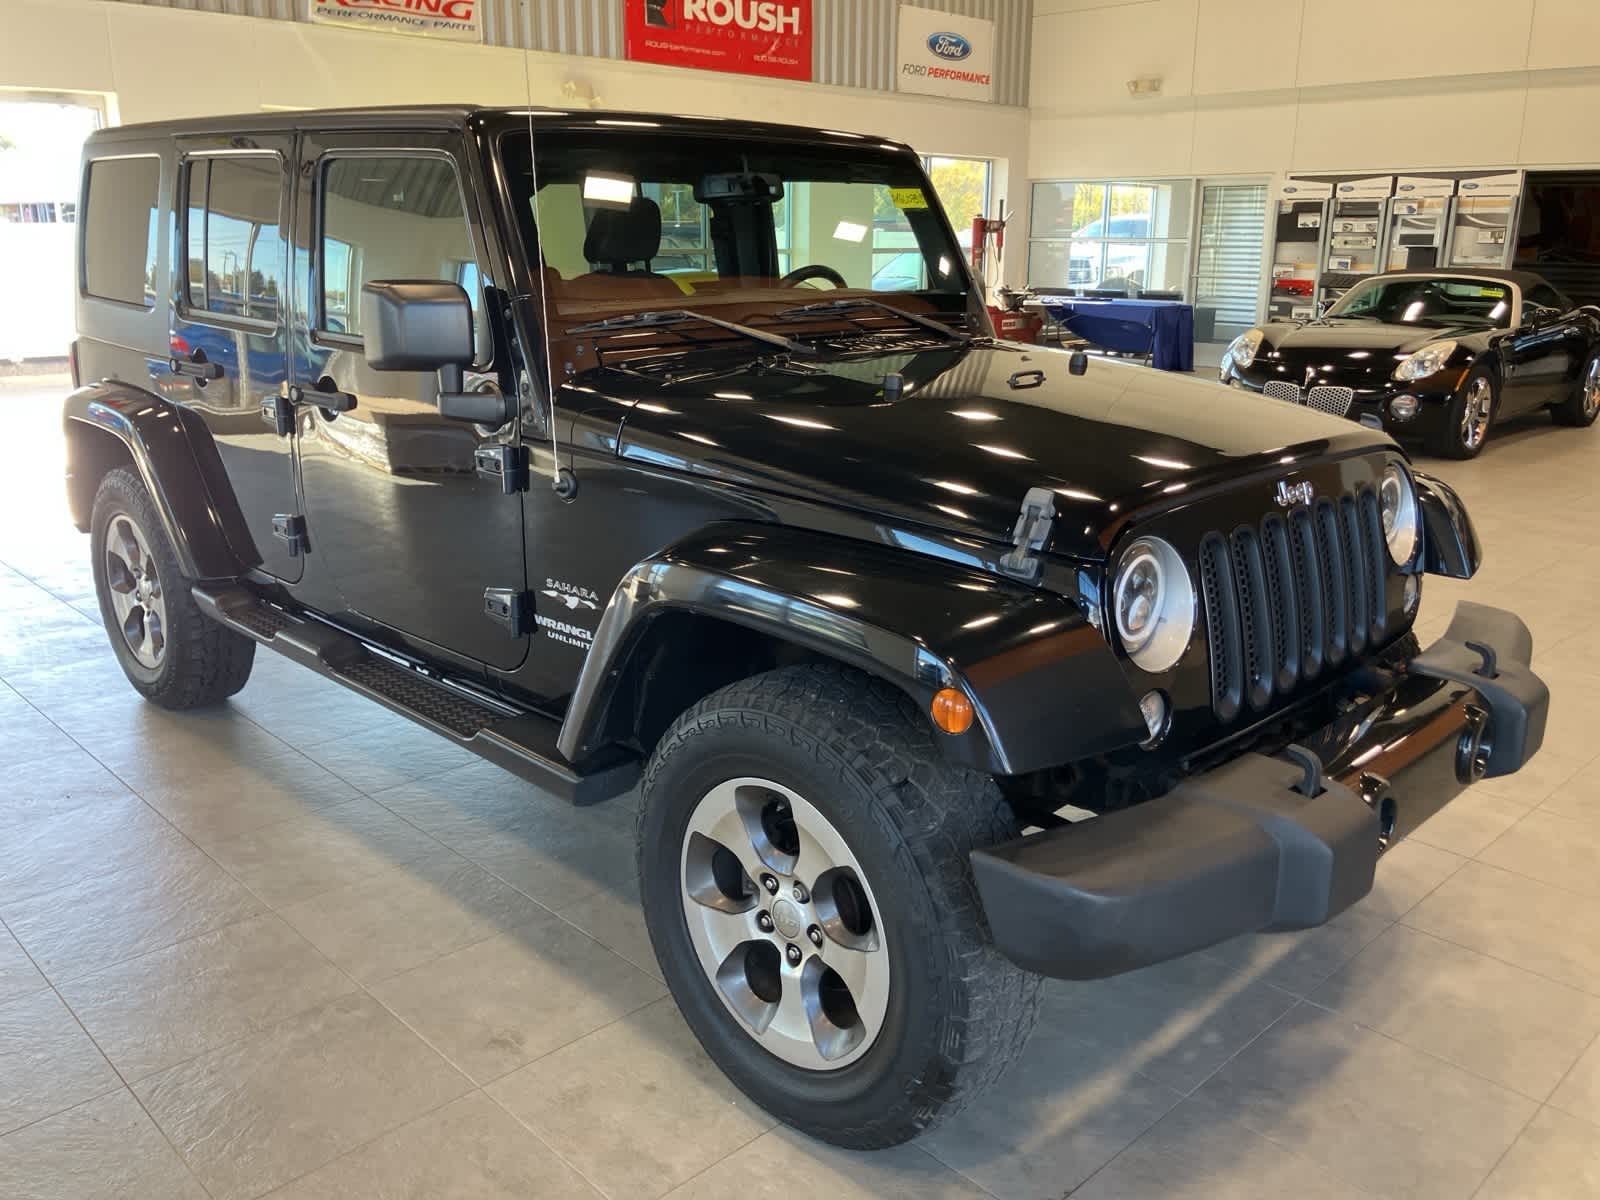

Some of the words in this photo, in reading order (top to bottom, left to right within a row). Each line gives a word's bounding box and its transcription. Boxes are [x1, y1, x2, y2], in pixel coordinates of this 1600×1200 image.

[317, 6, 425, 26] PERFORMANCE
[433, 21, 476, 32] PARTS
[683, 0, 800, 35] ROUSH
[936, 35, 964, 56] Ford
[902, 63, 927, 77] FORD
[927, 66, 991, 86] PERFORMANCE
[1273, 480, 1313, 506] Jeep
[546, 578, 599, 601] SAHARA
